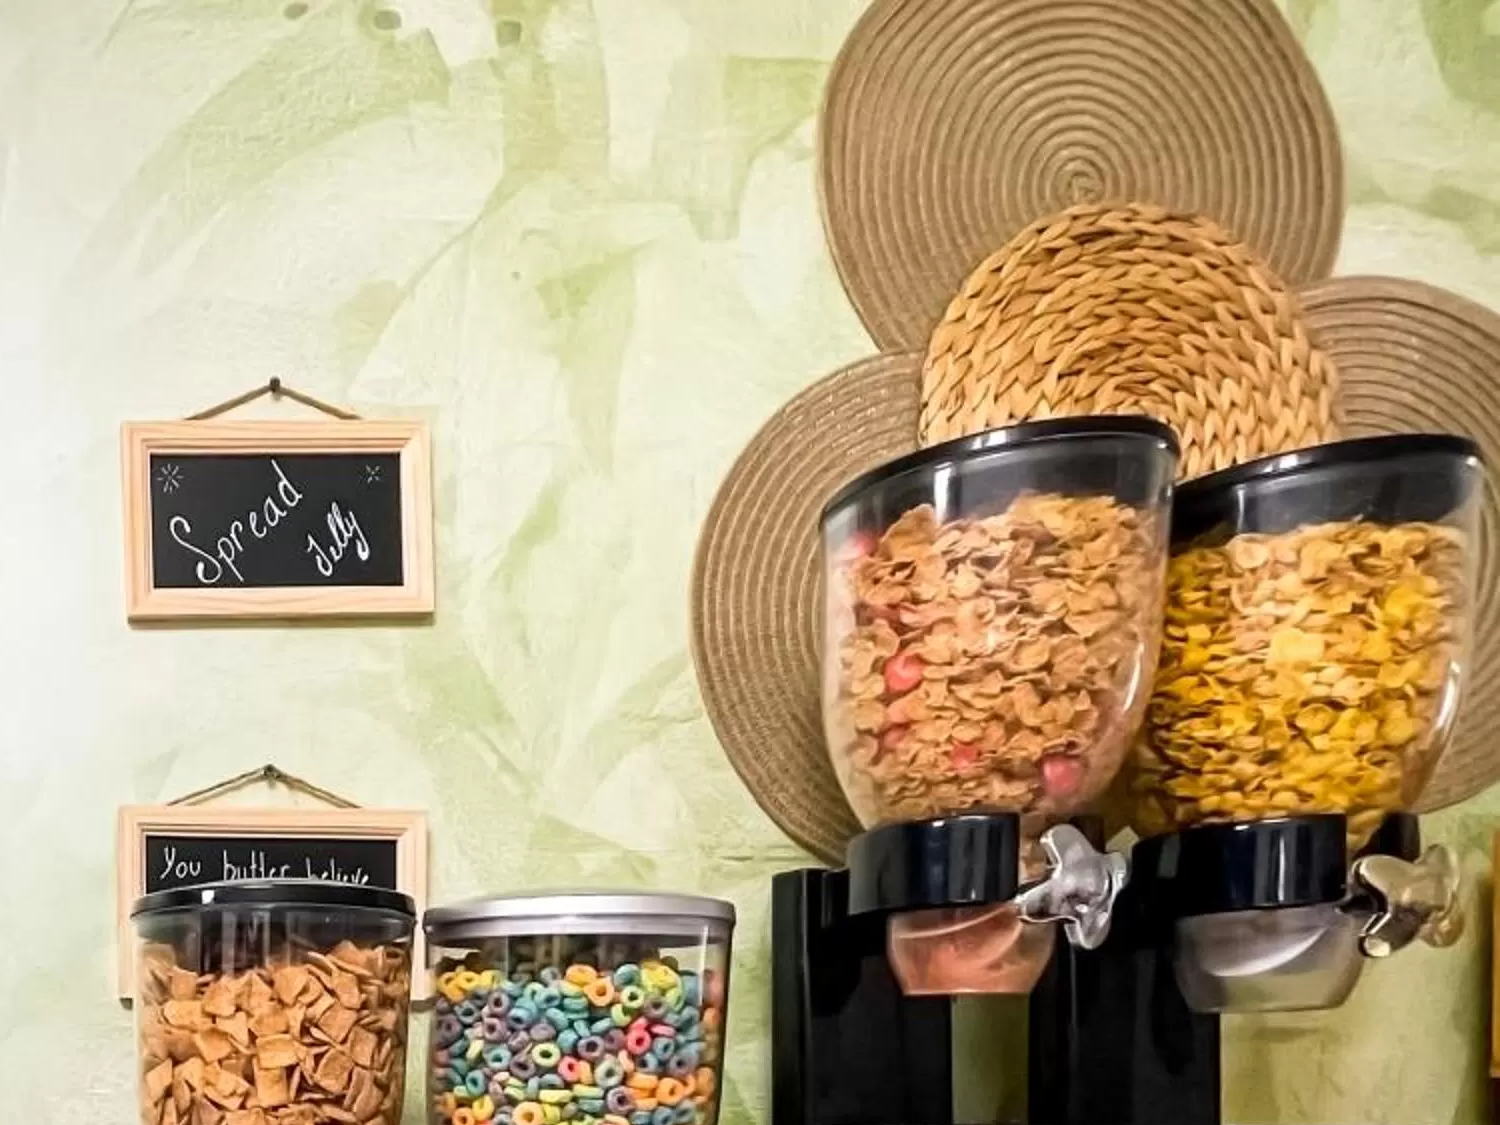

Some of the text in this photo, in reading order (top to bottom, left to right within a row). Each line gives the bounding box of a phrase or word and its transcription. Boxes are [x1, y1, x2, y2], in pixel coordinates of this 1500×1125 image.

[169, 459, 302, 583] Spread
[307, 501, 370, 577] Jelly
[160, 846, 201, 880] You
[223, 850, 291, 880] butter
